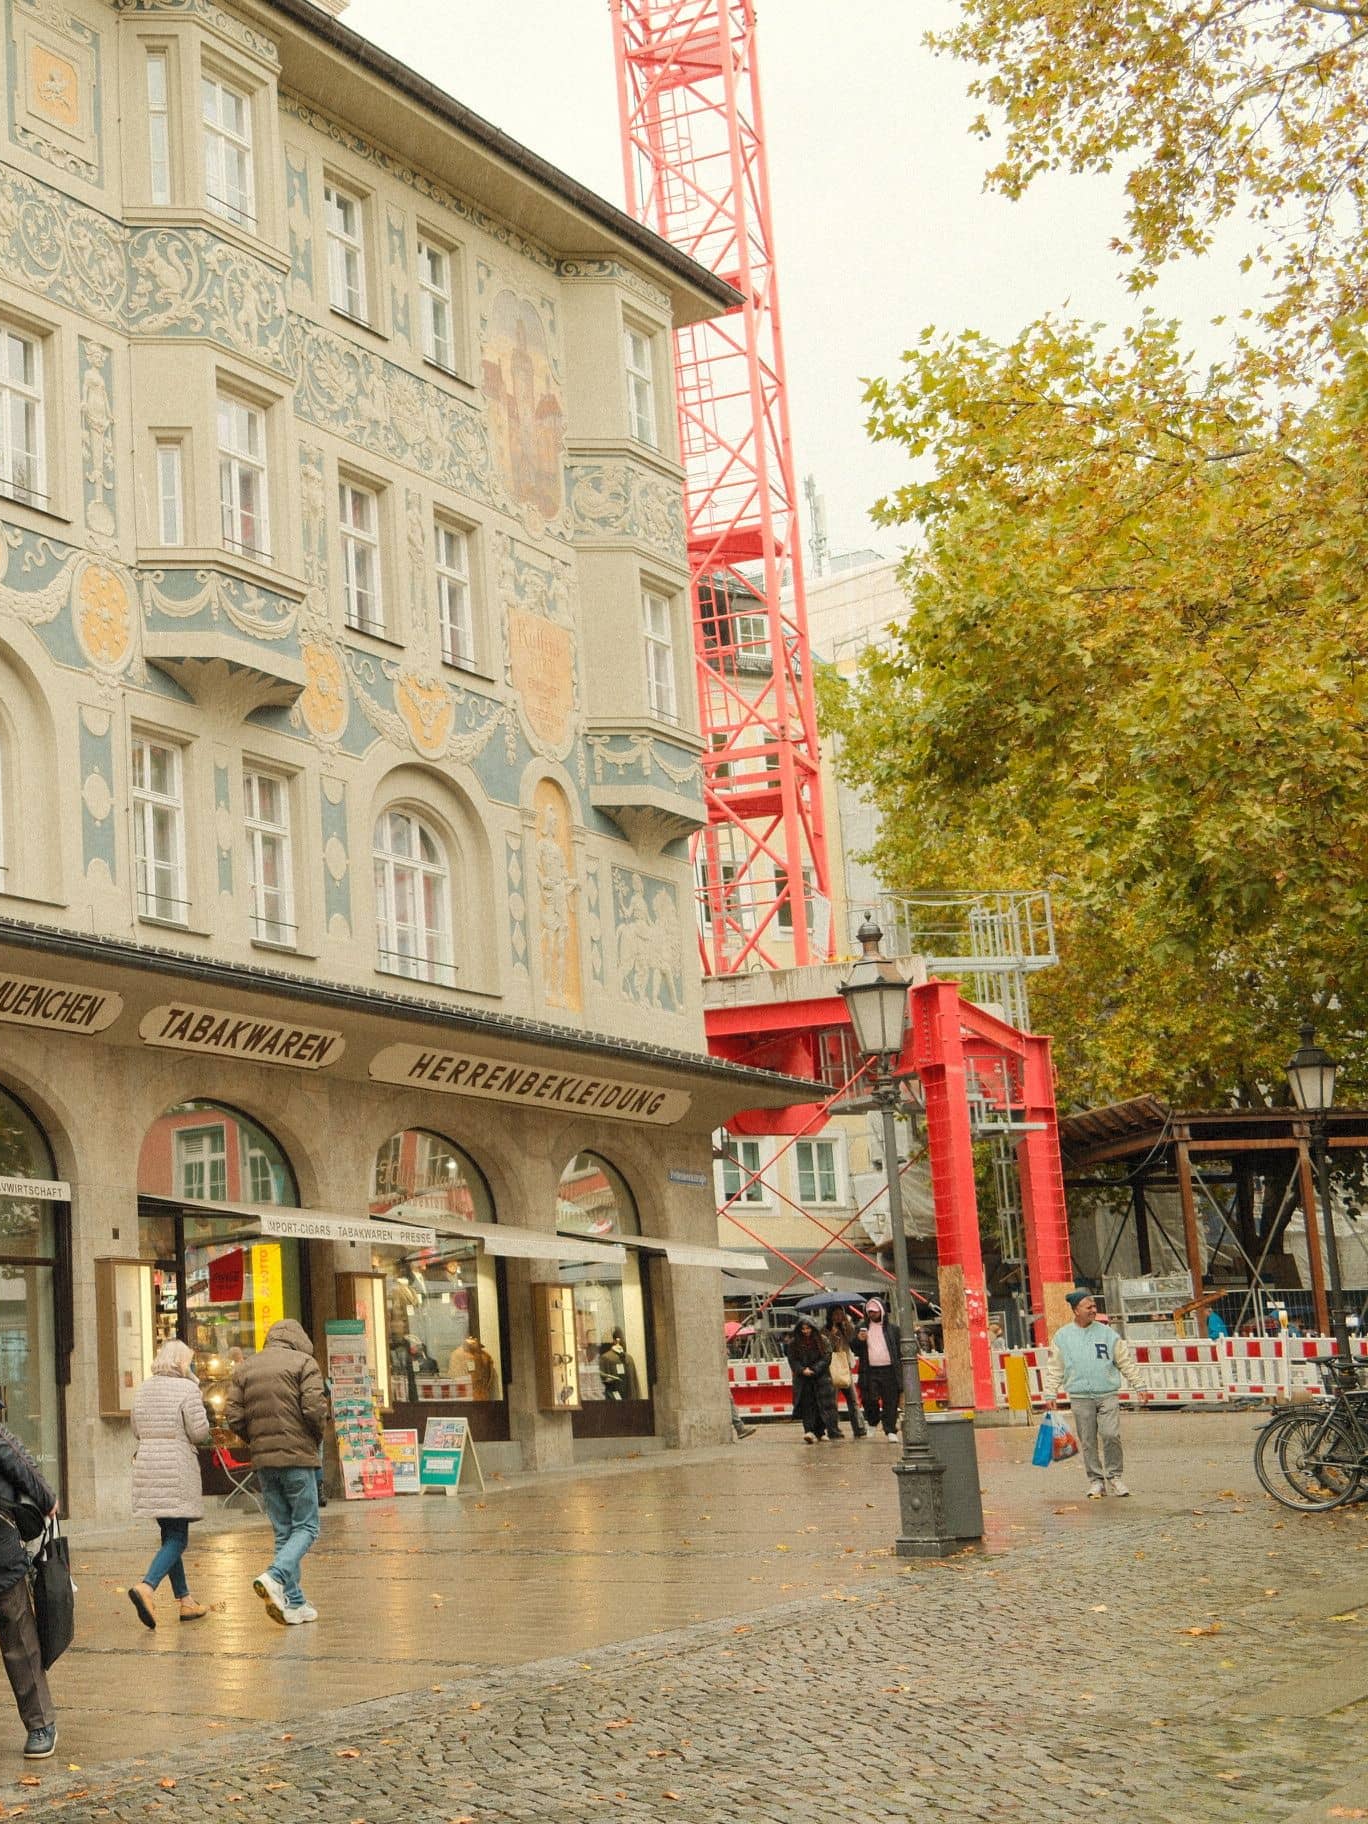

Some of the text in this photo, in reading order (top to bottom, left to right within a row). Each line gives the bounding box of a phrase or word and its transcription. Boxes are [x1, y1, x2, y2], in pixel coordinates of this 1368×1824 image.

[159, 1009, 335, 1062] TABAKWAREN
[408, 1052, 666, 1115] HERRENBEKLEIDUNG
[337, 1226, 392, 1240] TABAKWAREN
[400, 1231, 432, 1243] PRESSE
[1095, 1343, 1110, 1360] R
